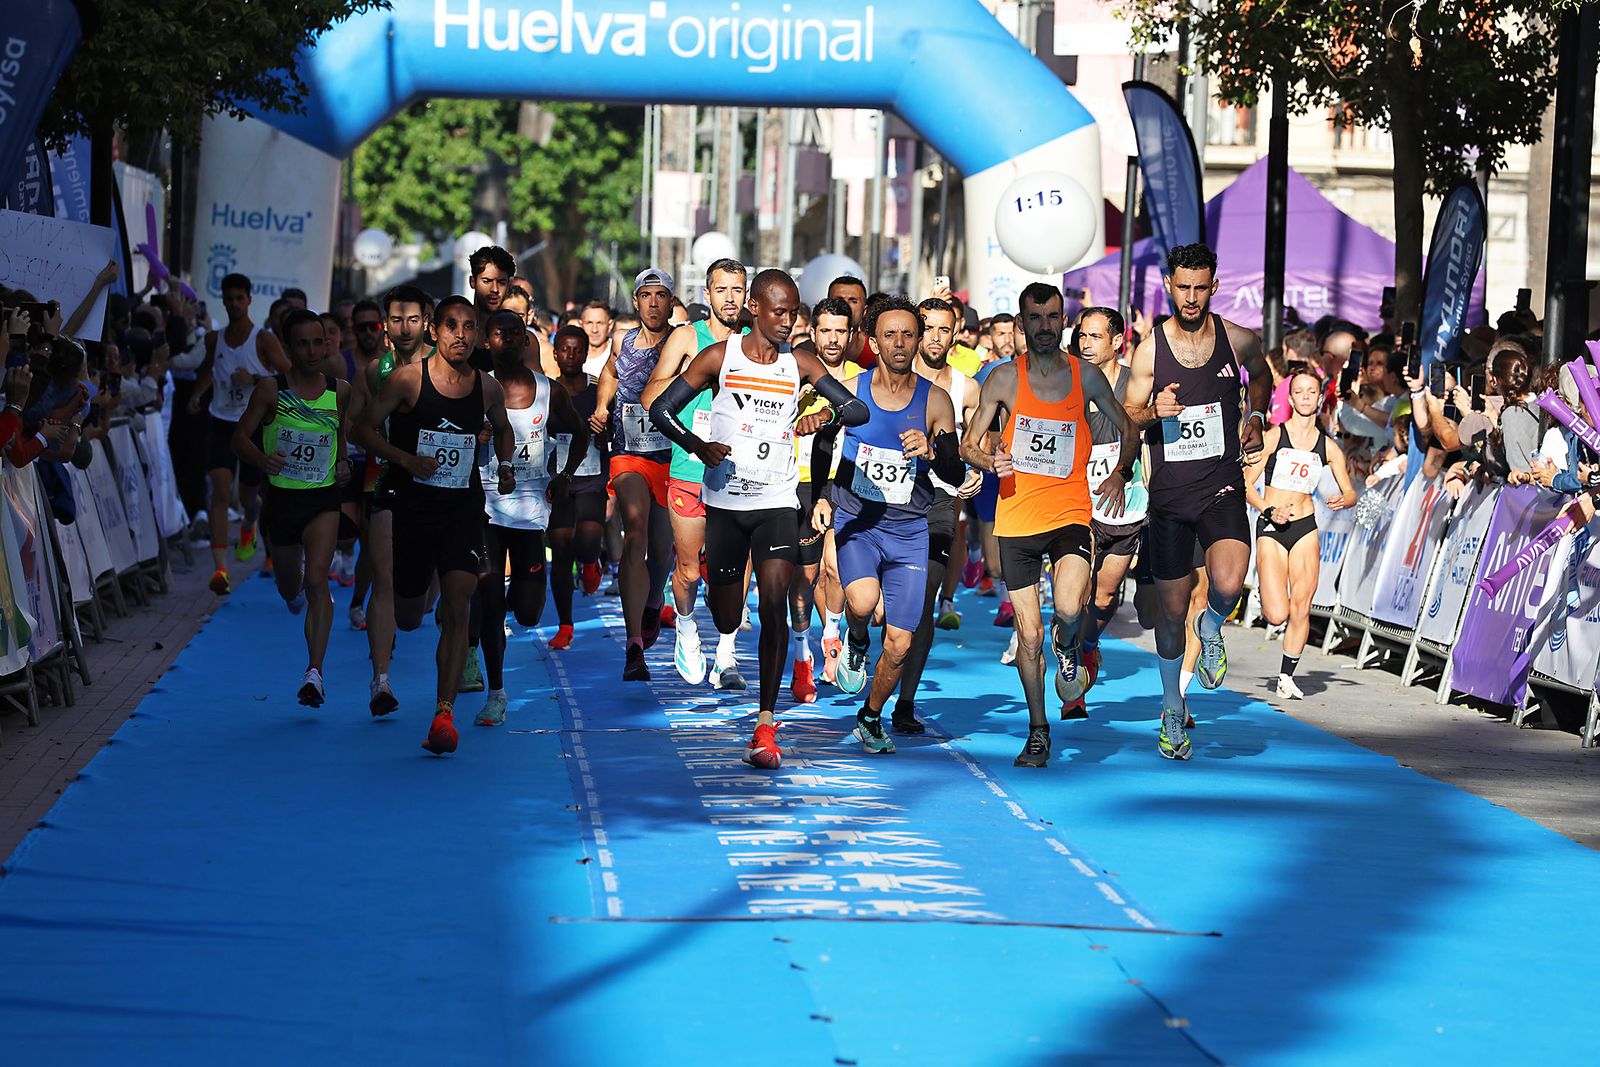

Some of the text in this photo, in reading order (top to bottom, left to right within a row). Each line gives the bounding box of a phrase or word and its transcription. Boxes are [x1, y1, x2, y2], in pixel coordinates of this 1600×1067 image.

[433, 0, 874, 73] Huelva original
[1014, 190, 1063, 213] 1:15
[211, 201, 305, 234] Huelva
[1433, 199, 1471, 362] HYUNDAI
[1232, 286, 1337, 309] AVTEL
[753, 398, 785, 410] VICKY
[755, 407, 780, 416] FOODS
[1180, 421, 1206, 440] 56
[291, 444, 316, 462] 49
[514, 444, 531, 461] 4
[756, 441, 771, 460] 9
[1029, 434, 1057, 455] 54
[434, 448, 460, 468] 69
[1024, 455, 1056, 465] MARHOUM
[861, 460, 911, 484] 1337
[1290, 461, 1310, 478] 76
[854, 484, 880, 497] Huelva
[1516, 525, 1565, 571] AVATEL
